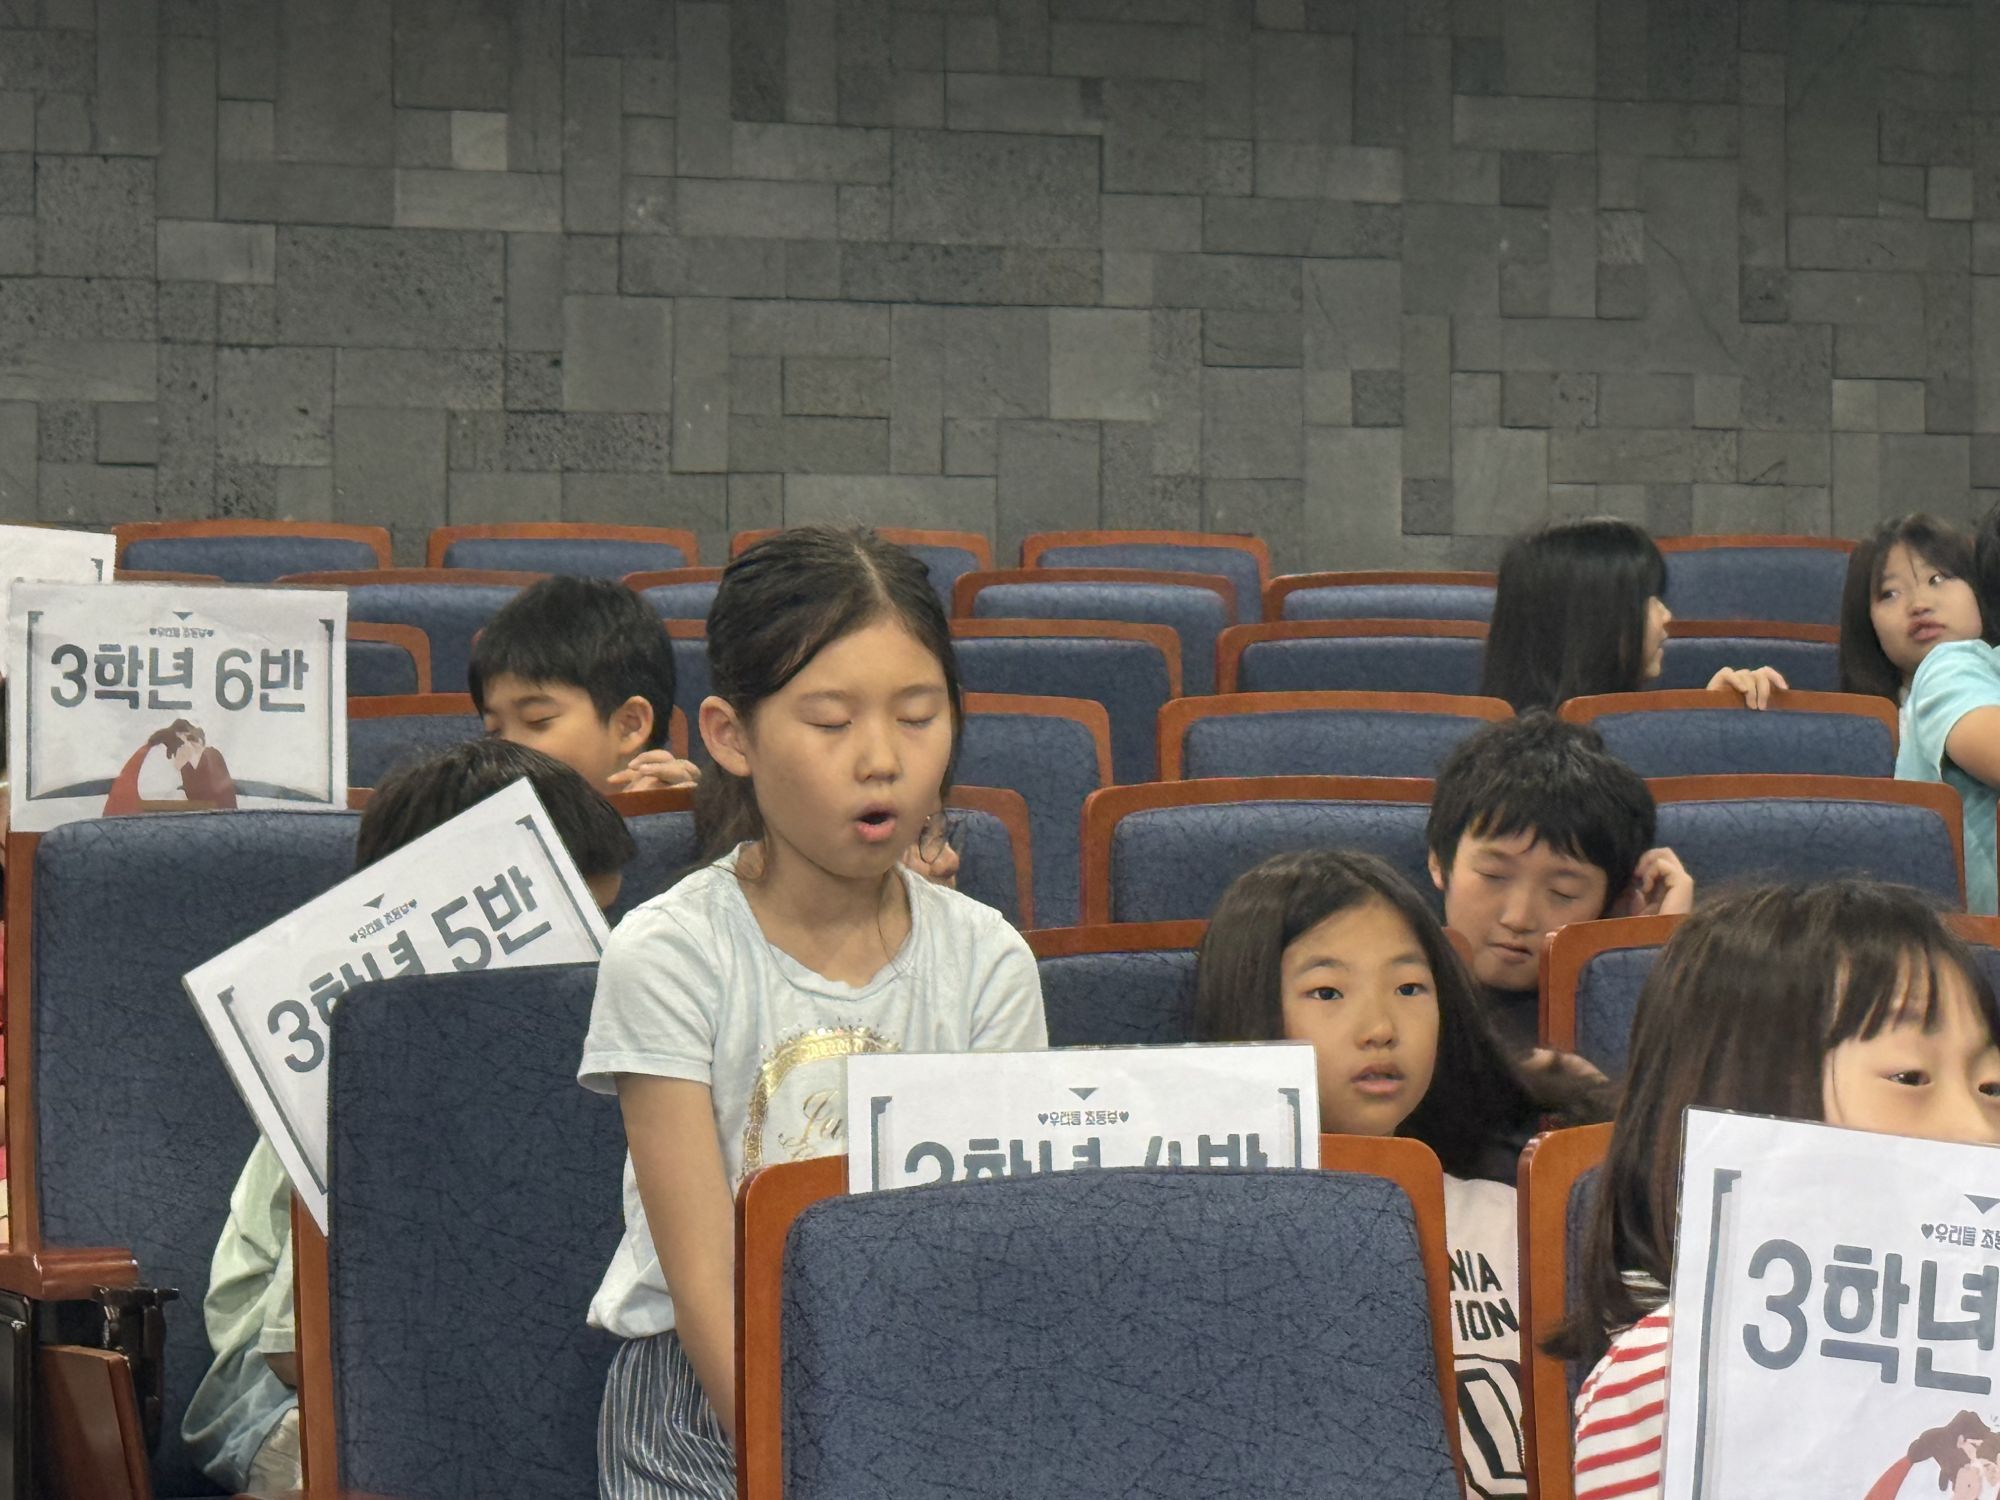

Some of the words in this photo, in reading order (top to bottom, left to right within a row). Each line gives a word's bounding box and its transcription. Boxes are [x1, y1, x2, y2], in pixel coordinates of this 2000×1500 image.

[51, 644, 194, 710] 3학년
[215, 648, 309, 712] 6반
[431, 865, 553, 971] 5반
[1935, 1223, 1977, 1247] 우리들
[1742, 1238, 2000, 1396] 3학년
